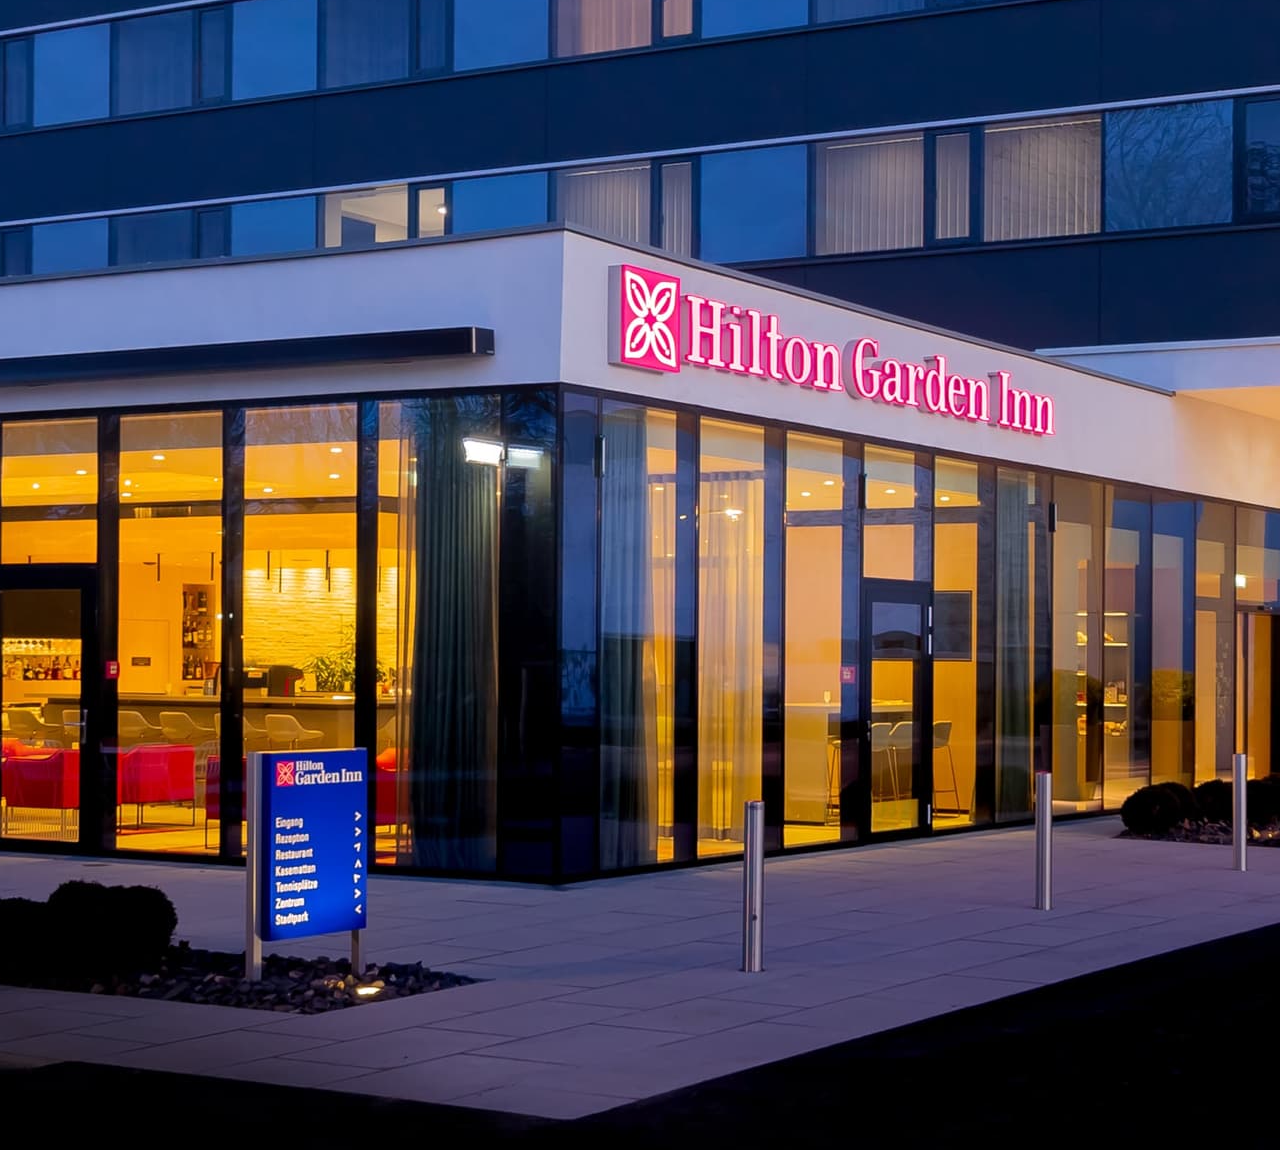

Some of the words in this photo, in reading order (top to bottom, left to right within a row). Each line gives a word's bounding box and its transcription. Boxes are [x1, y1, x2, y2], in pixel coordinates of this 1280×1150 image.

[685, 293, 843, 392] Hilton
[854, 337, 990, 422] Garden
[998, 369, 1056, 436] Inn
[296, 760, 324, 771] Hilton
[295, 769, 340, 786] Garden
[341, 768, 363, 783] Inn
[275, 817, 303, 829] Eingang
[275, 833, 309, 845] Rezeption
[275, 848, 313, 860] Restaurant
[275, 864, 316, 877] Kasematten
[275, 879, 318, 893] Tennisplätze
[275, 897, 305, 910] Zentrum
[275, 910, 309, 926] Stadtpark
